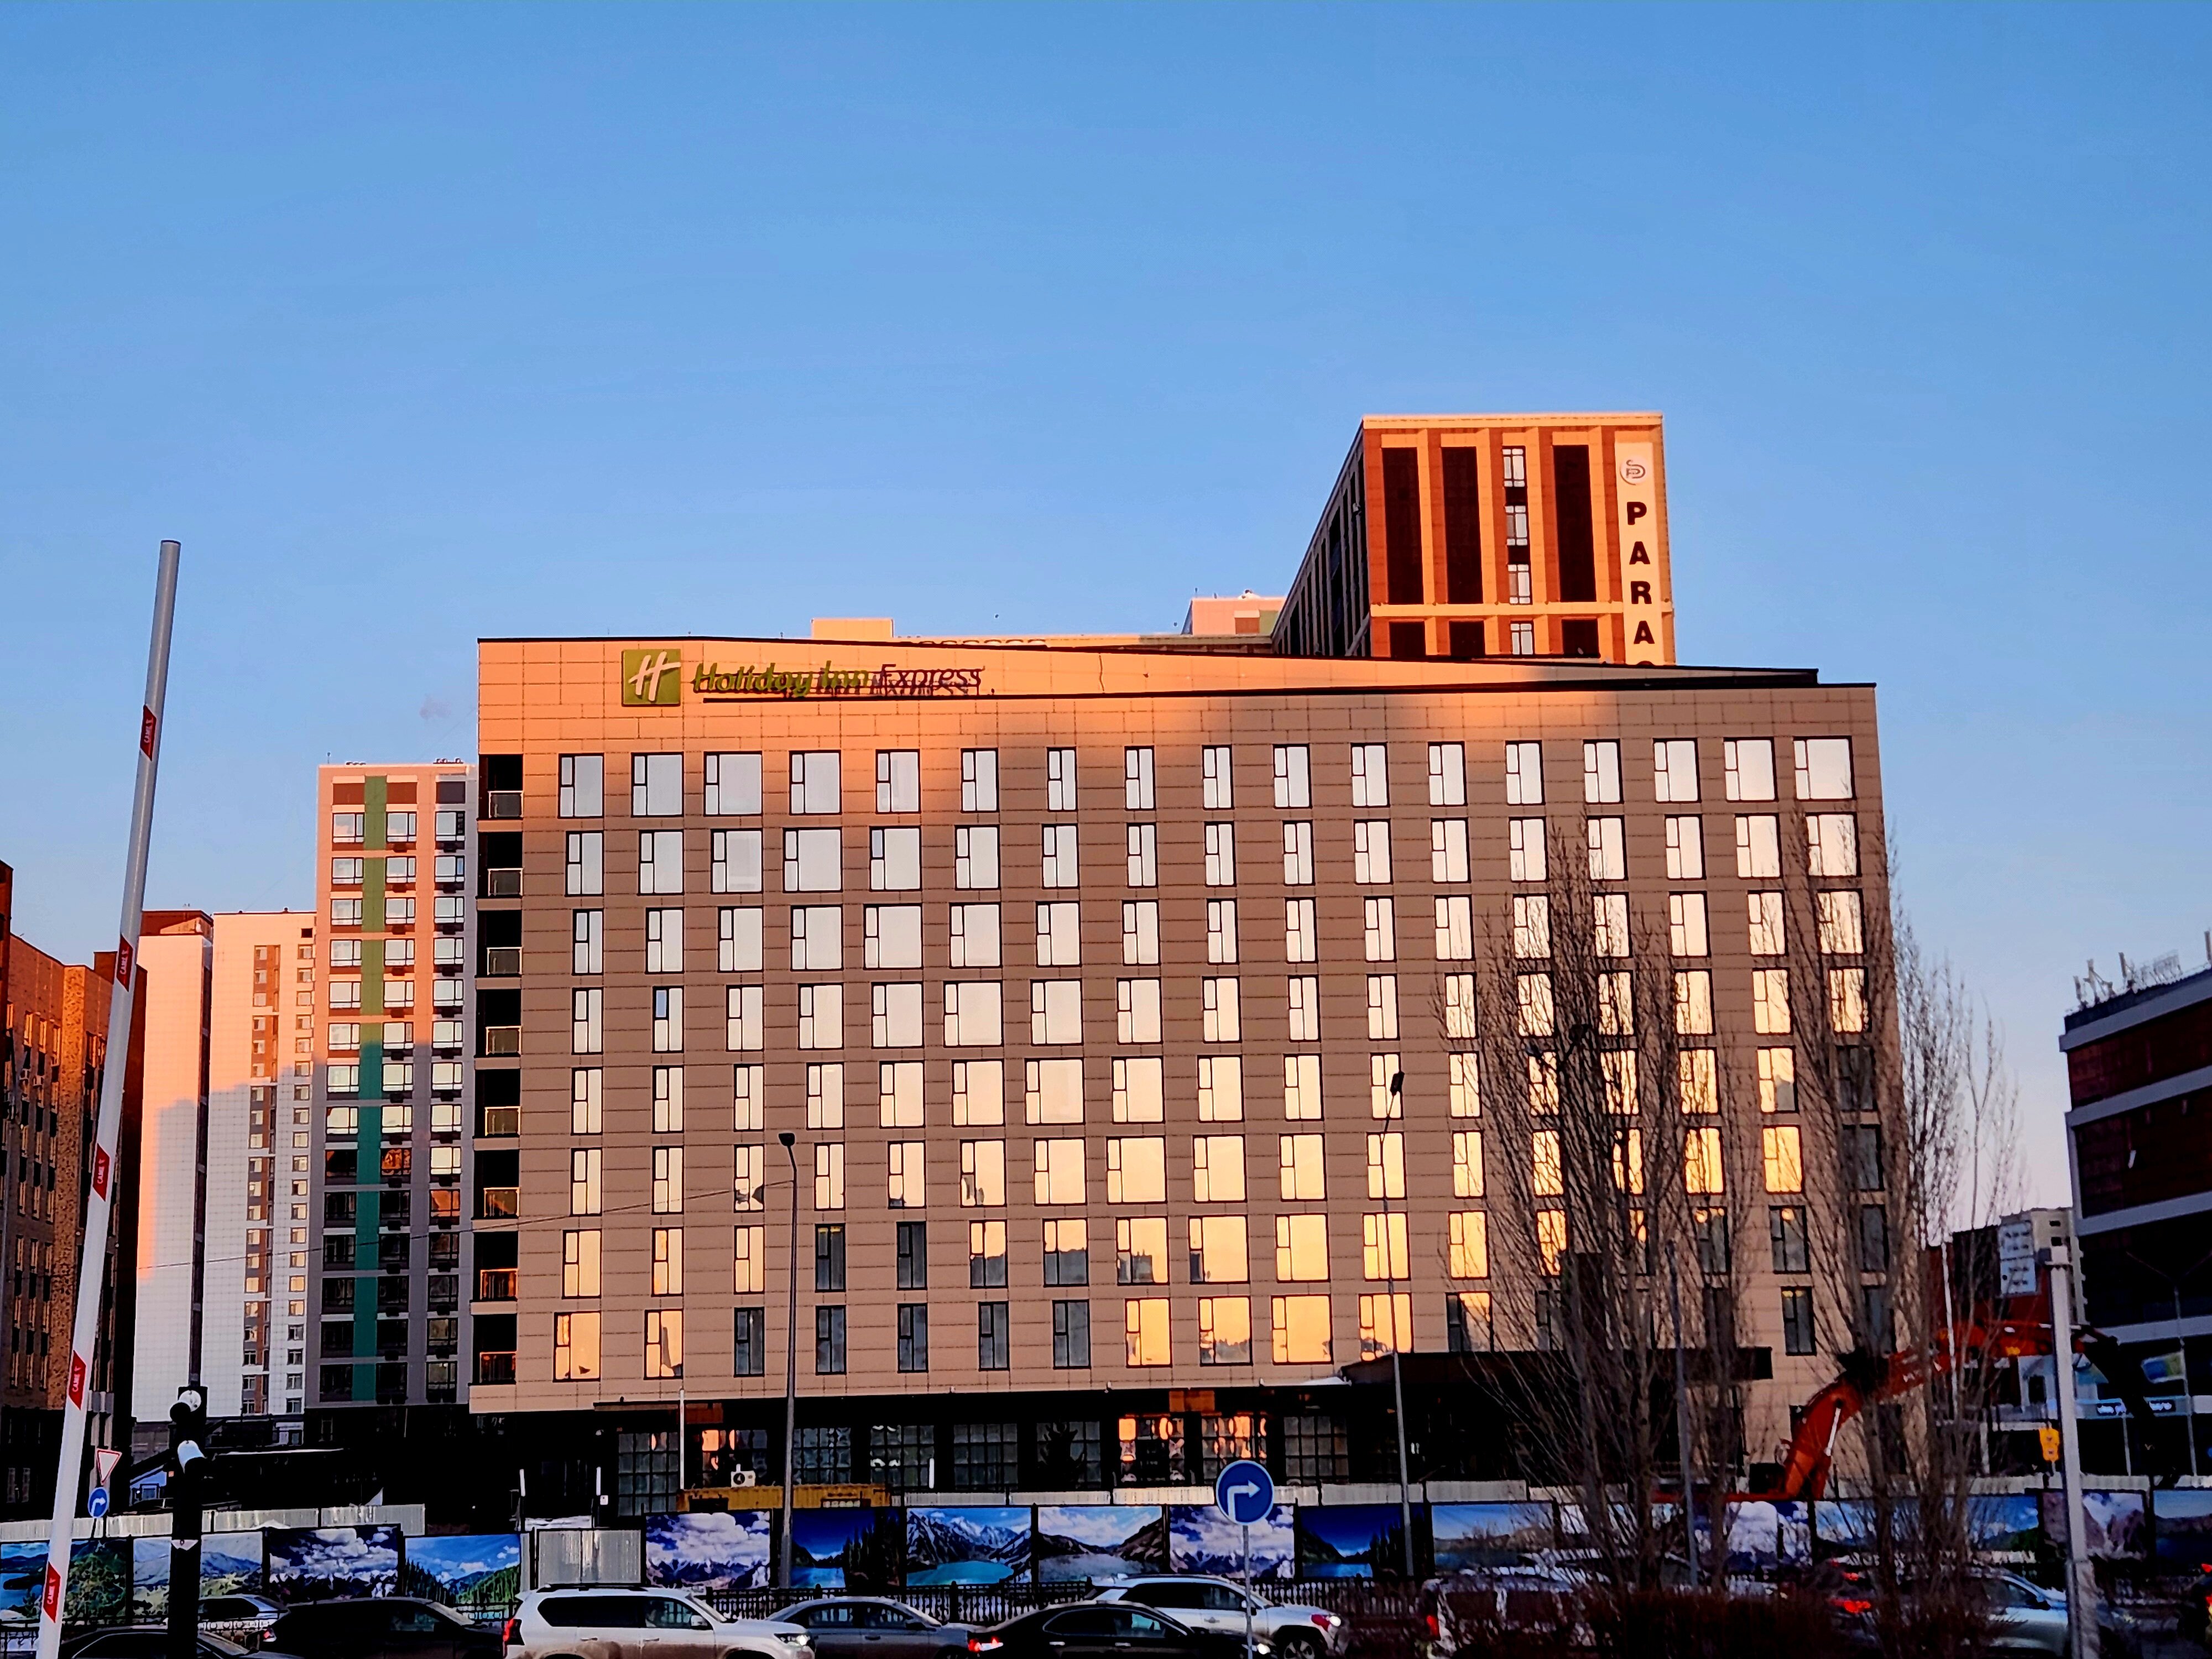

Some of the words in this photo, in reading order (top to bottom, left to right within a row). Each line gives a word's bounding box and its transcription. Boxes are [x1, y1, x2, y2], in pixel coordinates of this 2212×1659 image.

[1626, 501, 1655, 665] PARA
[693, 662, 813, 698] Holiday
[822, 660, 869, 689] Inn
[879, 664, 985, 695] Express
